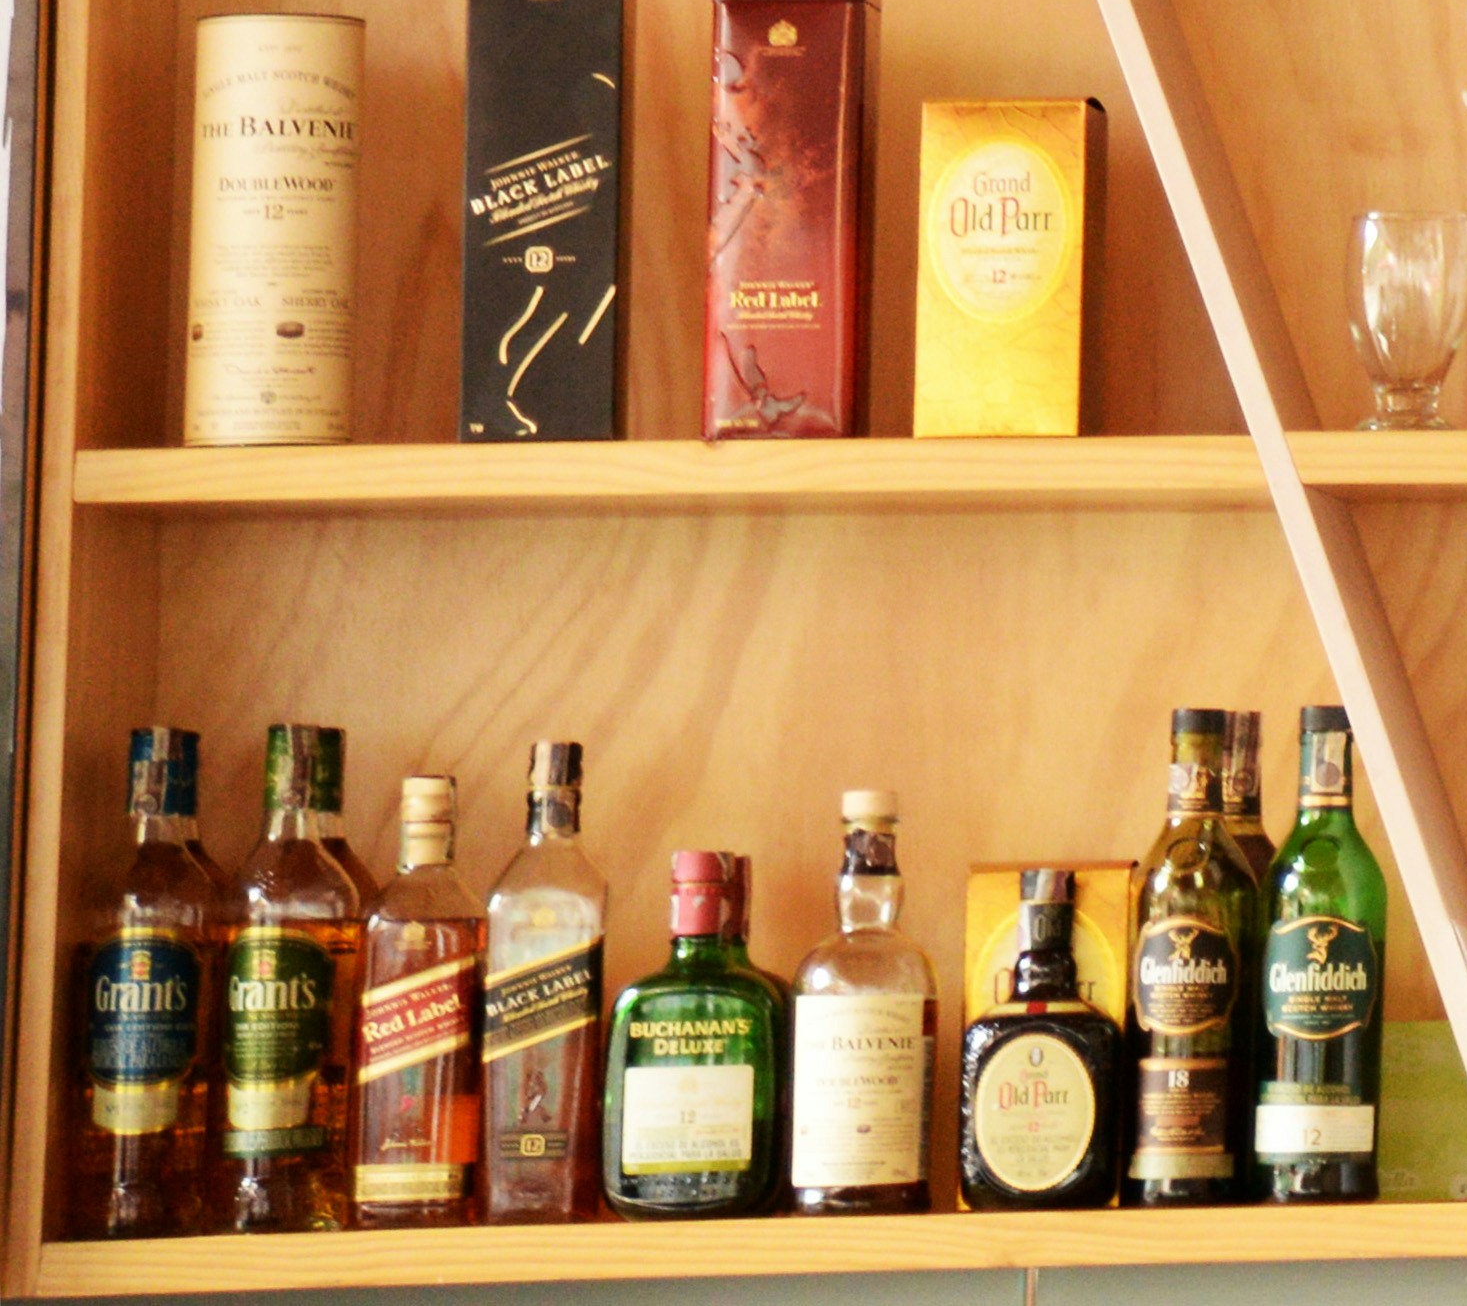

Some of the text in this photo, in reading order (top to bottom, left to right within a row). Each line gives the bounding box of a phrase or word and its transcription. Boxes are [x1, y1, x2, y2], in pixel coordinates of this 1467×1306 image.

[469, 154, 610, 216] BLACK LABEL
[972, 171, 1031, 197] Grand
[263, 203, 285, 220] 12
[949, 196, 1053, 238] Old Parr
[991, 269, 1008, 285] 12
[729, 290, 819, 308] Red Label
[1140, 956, 1228, 985] Glenfiddich
[1269, 962, 1367, 993] Glenfiddich
[94, 974, 188, 1013] Grant's
[229, 972, 317, 1012] Grant's
[486, 968, 592, 1018] BLACK LABEL
[361, 993, 462, 1043] Red Label
[629, 1018, 751, 1038] BUCHANAN'S
[1168, 1070, 1190, 1088] 18
[998, 1080, 1069, 1110] Old Parr
[680, 1108, 697, 1125] 12
[1302, 1129, 1322, 1146] 12
